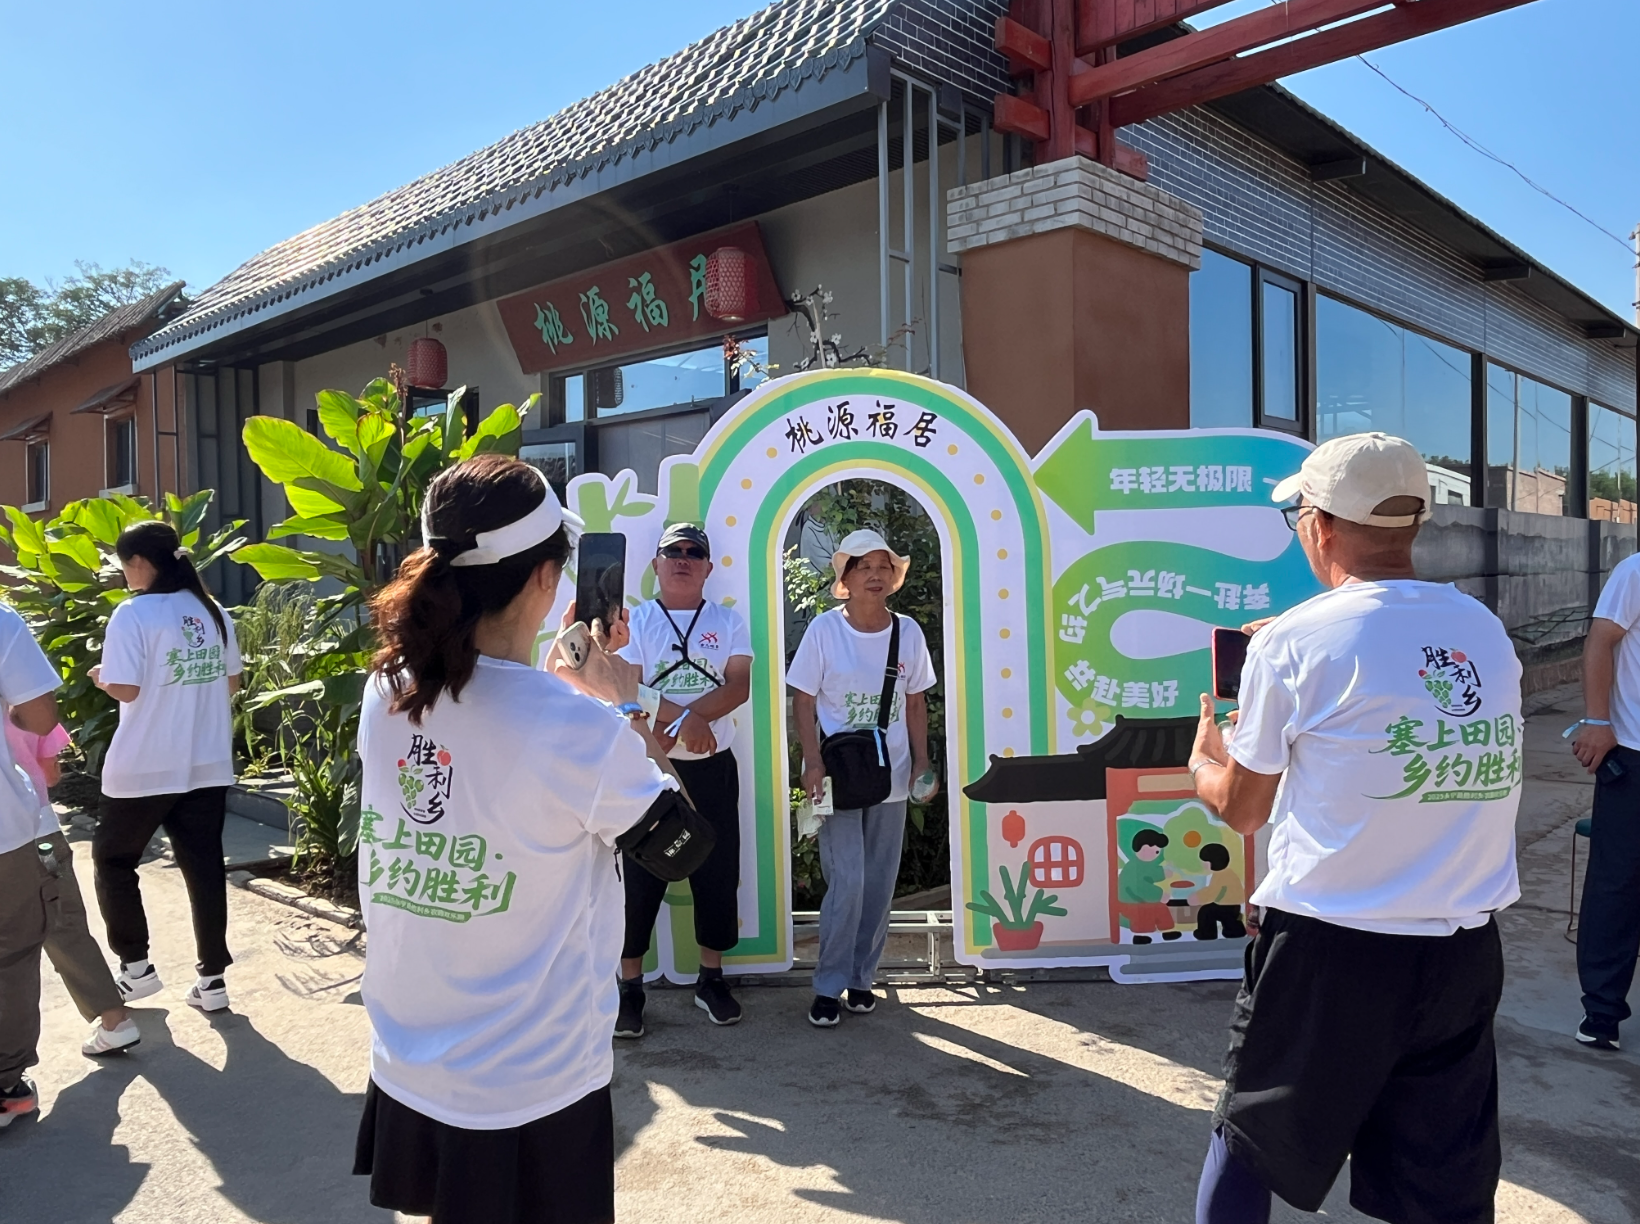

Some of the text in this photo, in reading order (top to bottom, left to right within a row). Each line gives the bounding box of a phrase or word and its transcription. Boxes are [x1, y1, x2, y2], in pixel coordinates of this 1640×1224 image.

[785, 400, 938, 454] 桃源福居
[1109, 465, 1253, 494] 年轻无极限
[1064, 659, 1179, 709] 奔赴美好
[1420, 645, 1482, 717] 胜利乡
[401, 733, 454, 825] 胜利乡
[1361, 749, 1523, 799] 乡约胜利
